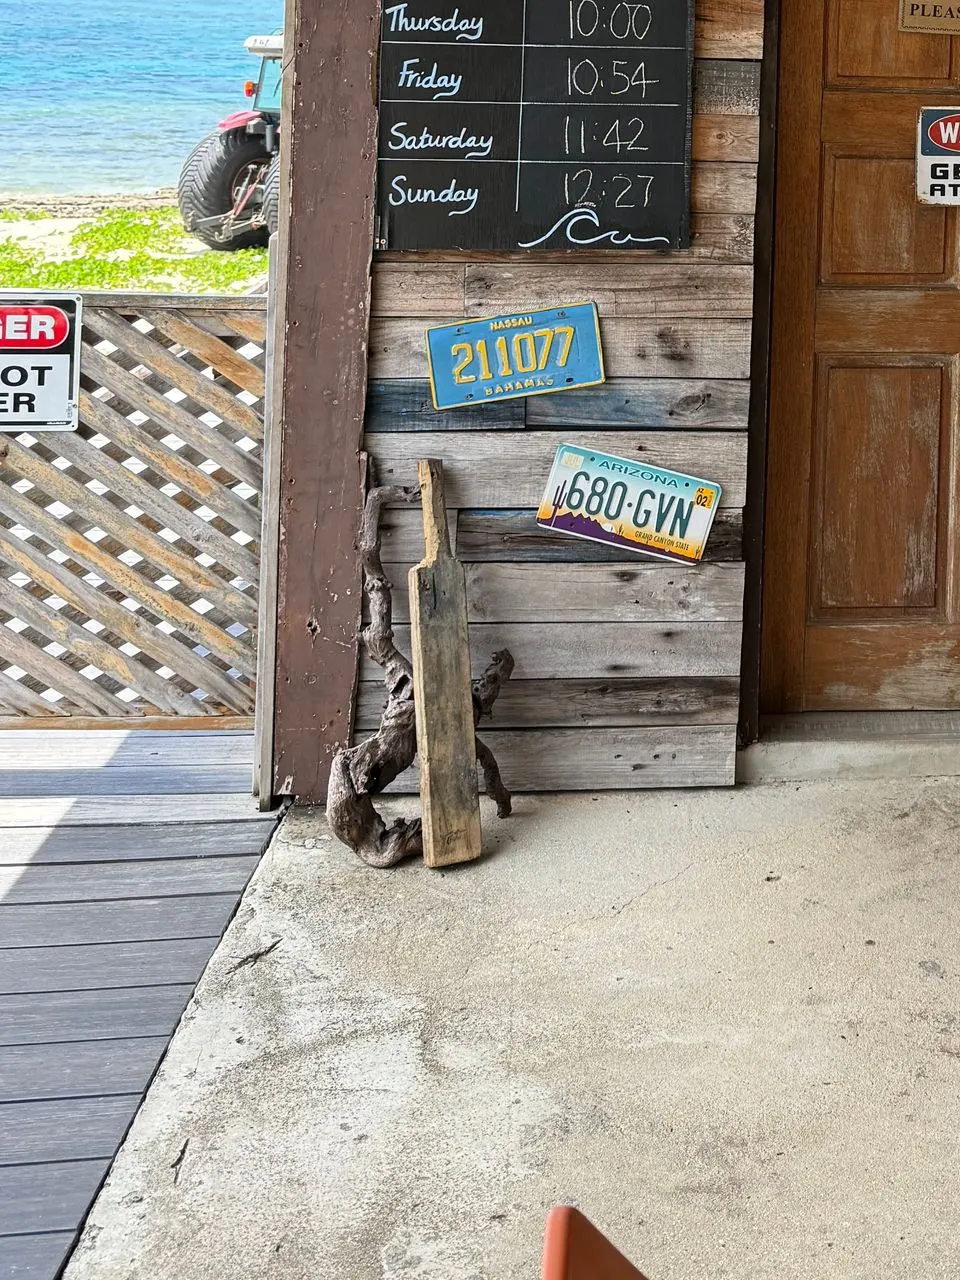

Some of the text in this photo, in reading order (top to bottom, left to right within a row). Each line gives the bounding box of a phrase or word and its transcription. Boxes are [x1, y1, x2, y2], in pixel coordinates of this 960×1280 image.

[385, 2, 484, 41] Thursday
[397, 56, 660, 100] Friday 10:54
[388, 115, 650, 159] Saturday 11:42
[388, 168, 655, 217] Sunday 12:27
[489, 316, 533, 331] NASSAU
[450, 325, 576, 385] 211077
[484, 376, 555, 396] BAHAMAS
[598, 459, 679, 489] ARIZONA
[696, 494, 708, 507] 02
[634, 530, 690, 551] GRAND CANYON STATE
